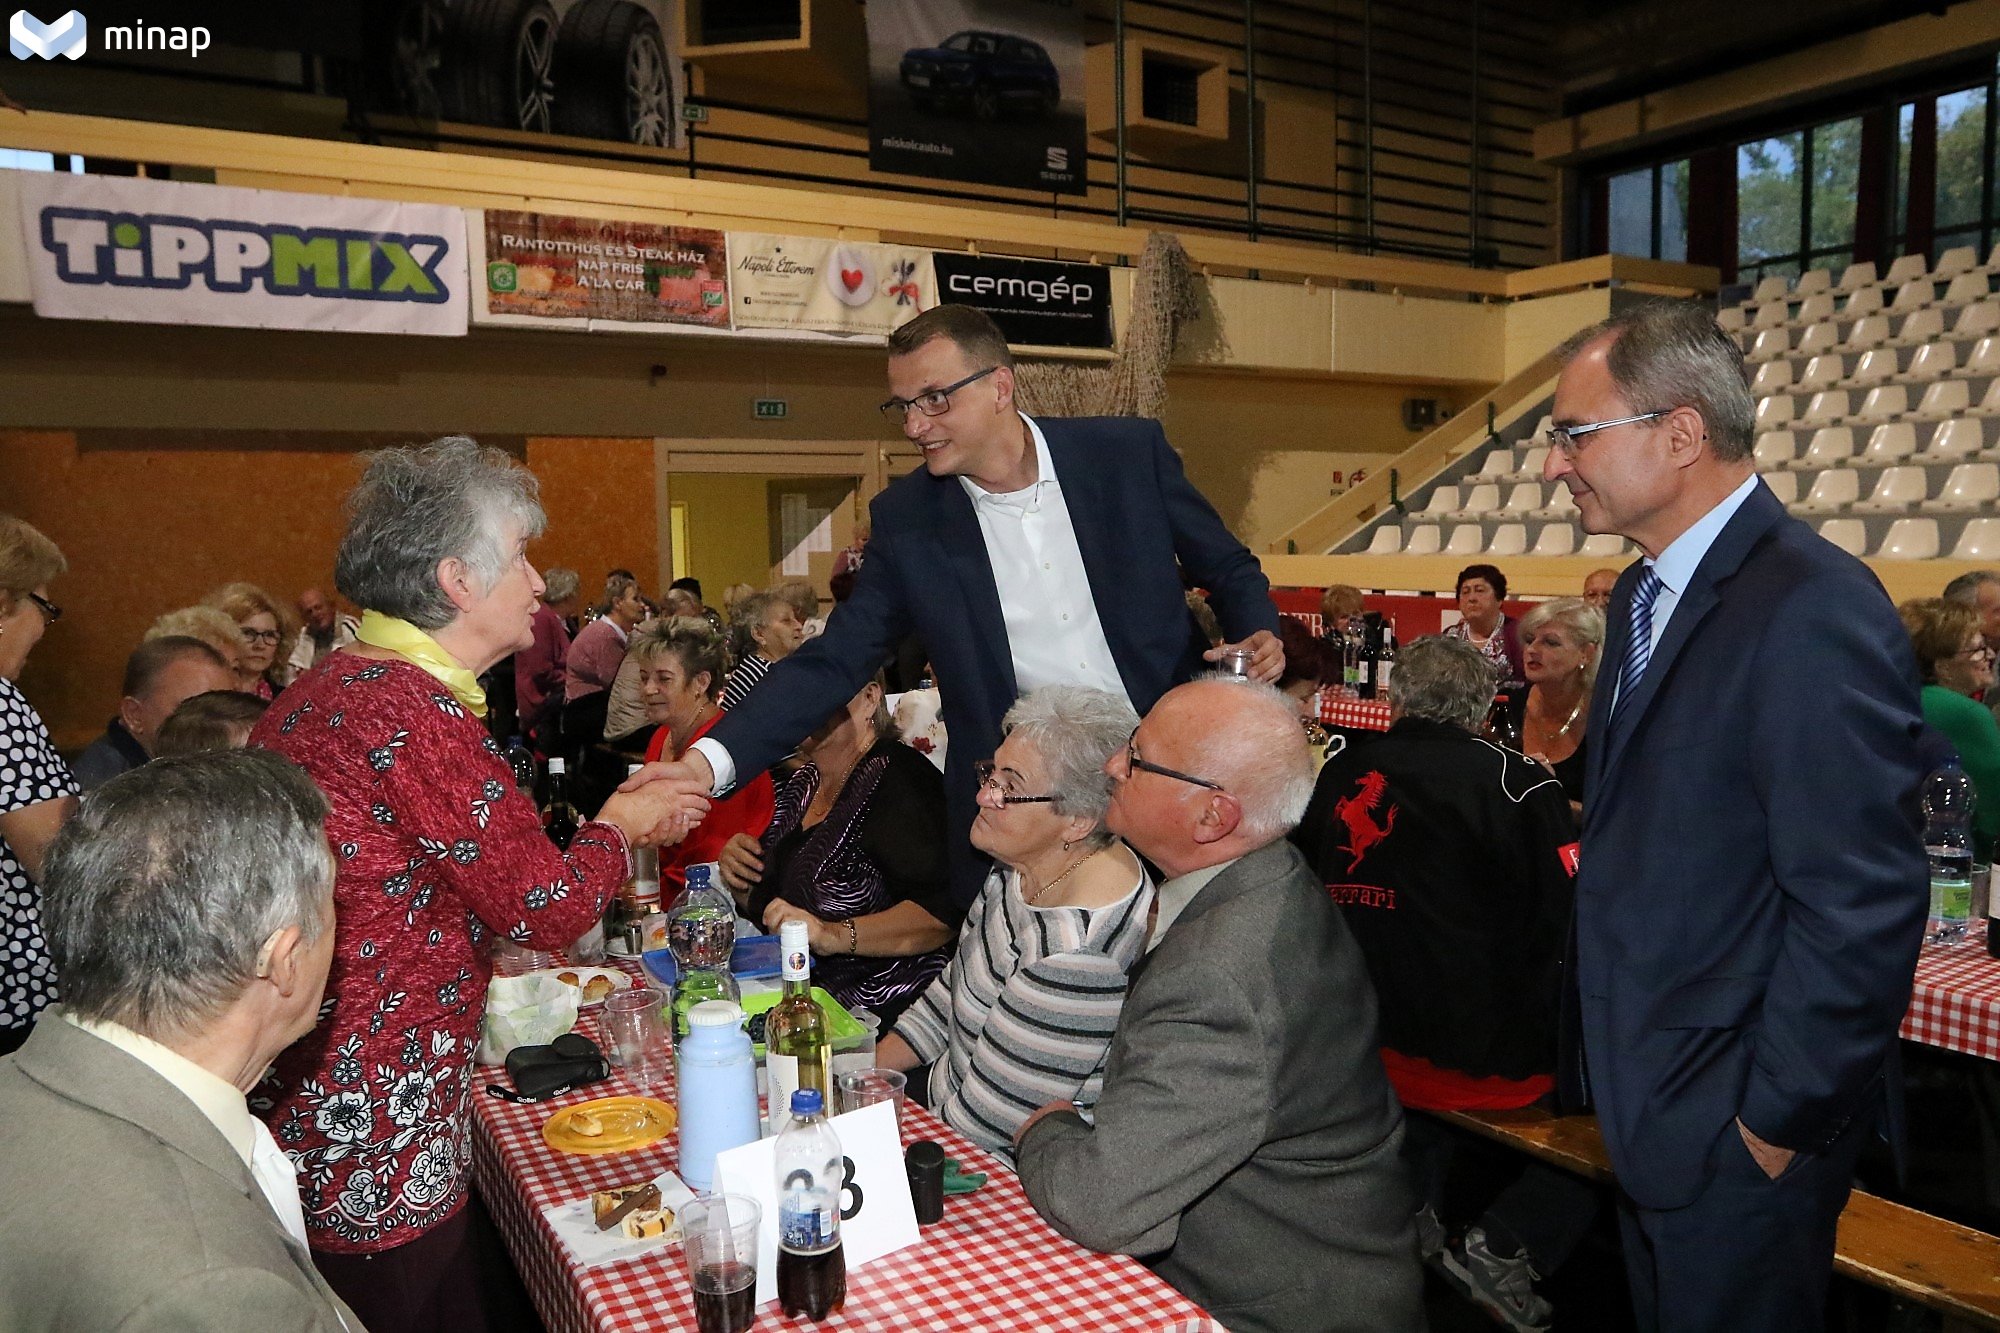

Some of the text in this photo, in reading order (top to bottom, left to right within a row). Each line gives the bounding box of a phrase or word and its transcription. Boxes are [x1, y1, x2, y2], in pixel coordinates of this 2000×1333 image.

[1040, 171, 1074, 182] SEAT
[738, 255, 773, 276] Napoli
[950, 274, 1093, 305] cemgép
[1326, 885, 1396, 909] errari
